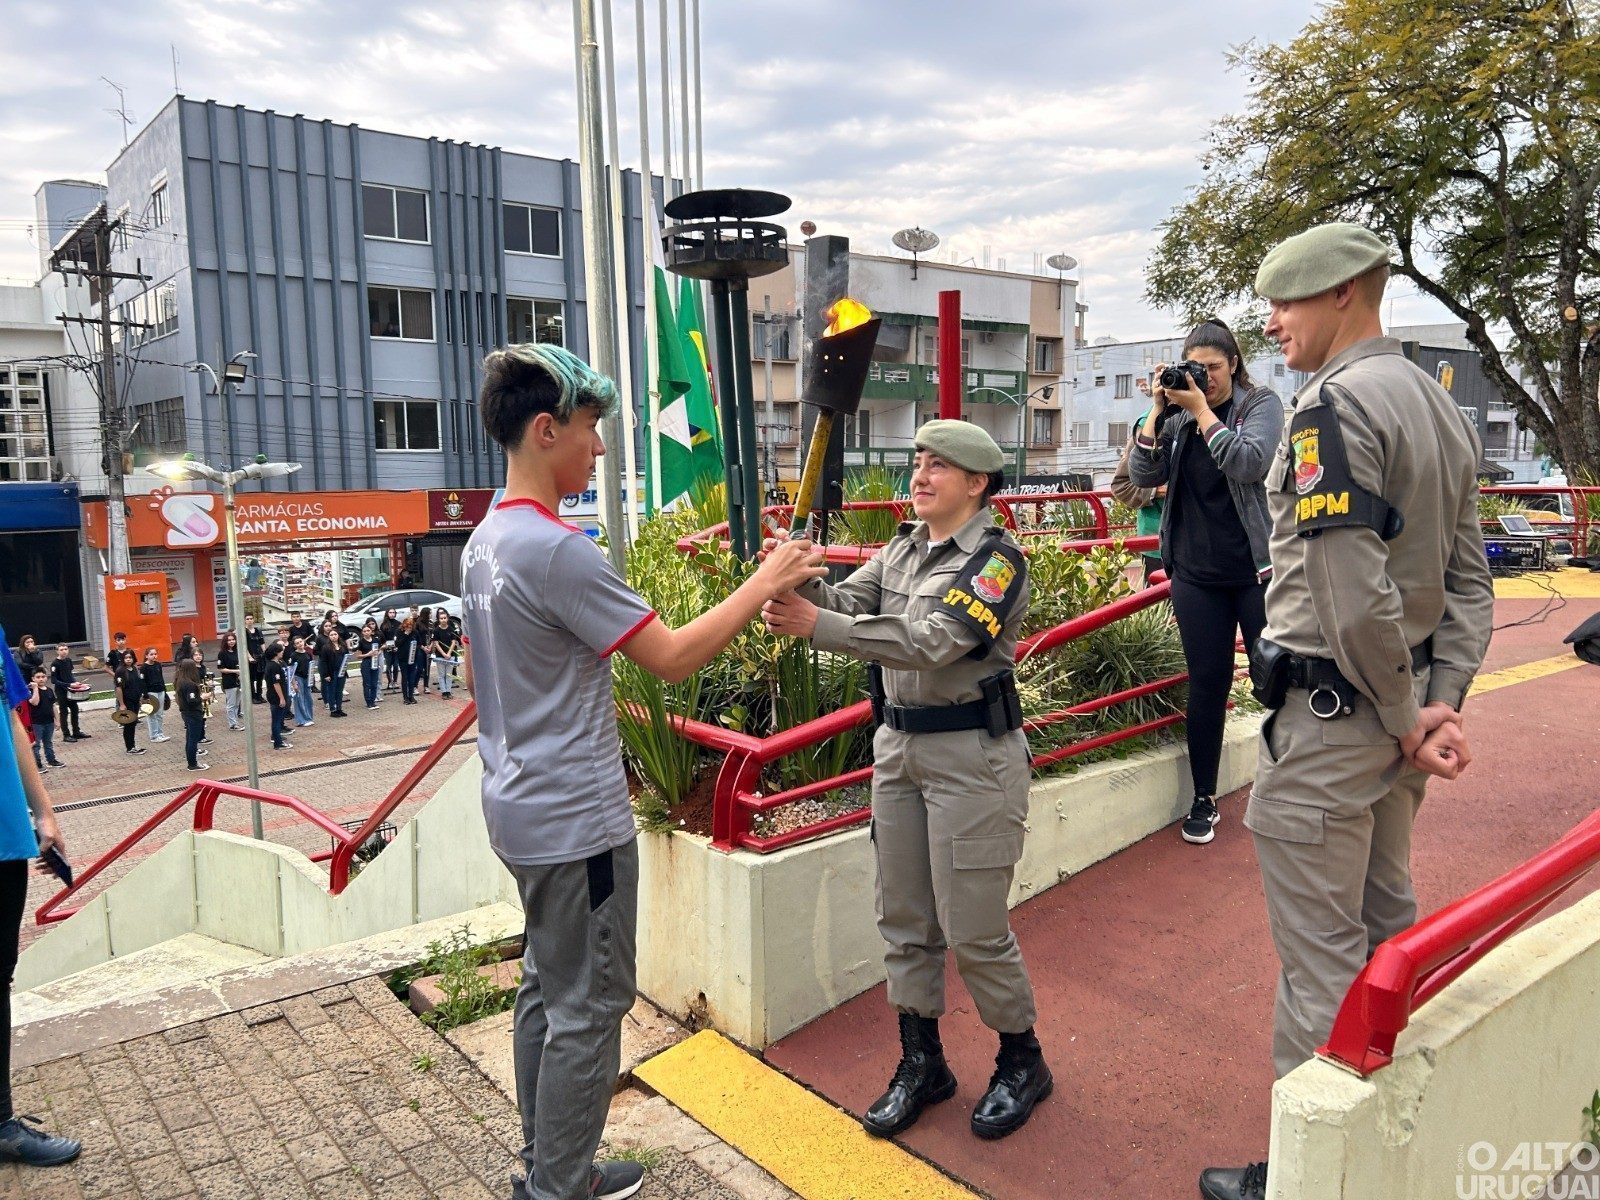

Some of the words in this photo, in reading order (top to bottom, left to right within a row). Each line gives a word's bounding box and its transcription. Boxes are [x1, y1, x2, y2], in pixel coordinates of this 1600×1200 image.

[234, 519, 291, 534] SANTA
[297, 516, 388, 532] ECONOMIA
[135, 560, 185, 568] DESCONTOS
